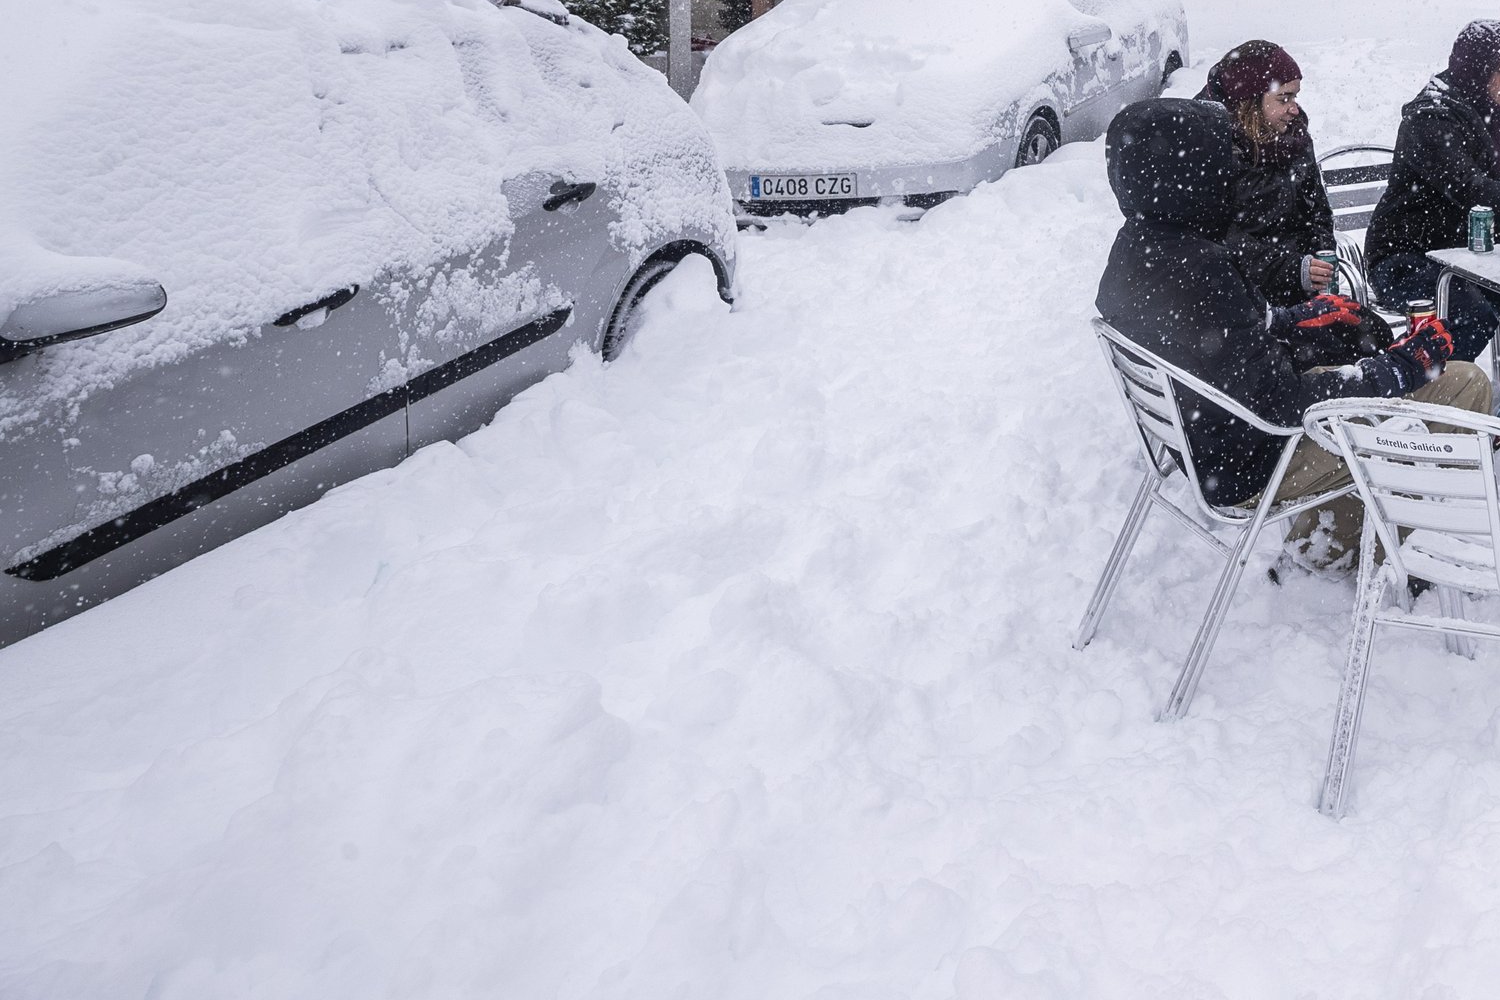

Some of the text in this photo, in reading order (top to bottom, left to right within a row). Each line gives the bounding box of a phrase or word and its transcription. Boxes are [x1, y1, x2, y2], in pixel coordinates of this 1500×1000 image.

[763, 177, 852, 196] 0408 CZG
[1376, 436, 1442, 453] Estrella Galicia
